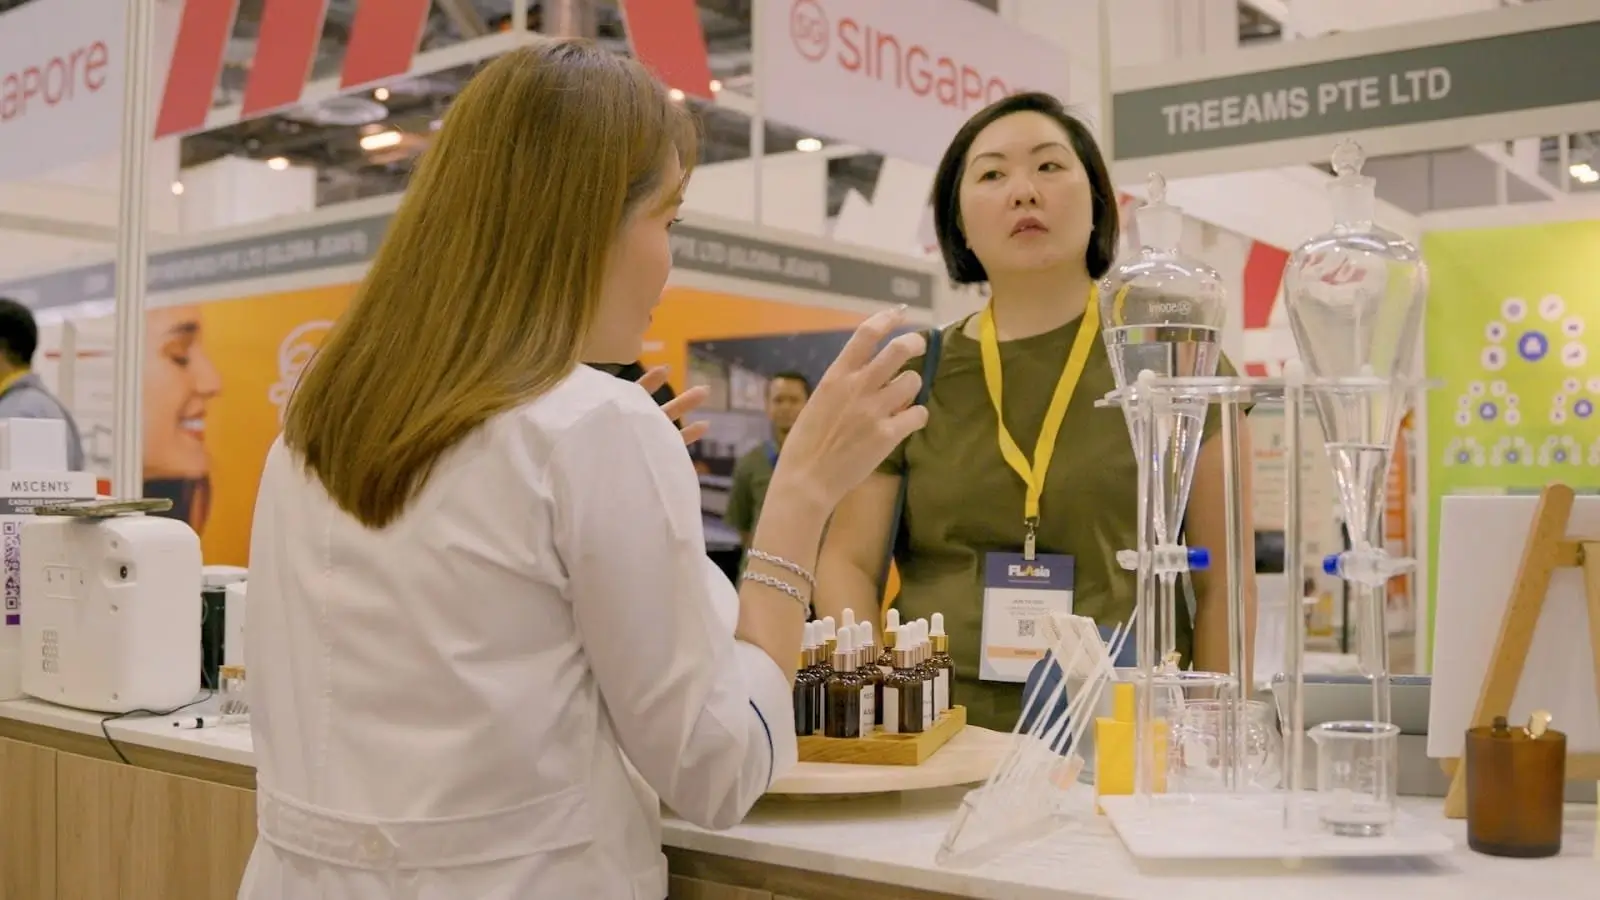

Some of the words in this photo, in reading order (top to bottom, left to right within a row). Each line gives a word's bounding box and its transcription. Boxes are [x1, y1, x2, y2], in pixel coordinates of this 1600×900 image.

[1161, 86, 1310, 135] TREEAMS
[1318, 76, 1380, 114] PTE
[1389, 66, 1452, 105] LTD
[11, 481, 70, 492] MSCENTS
